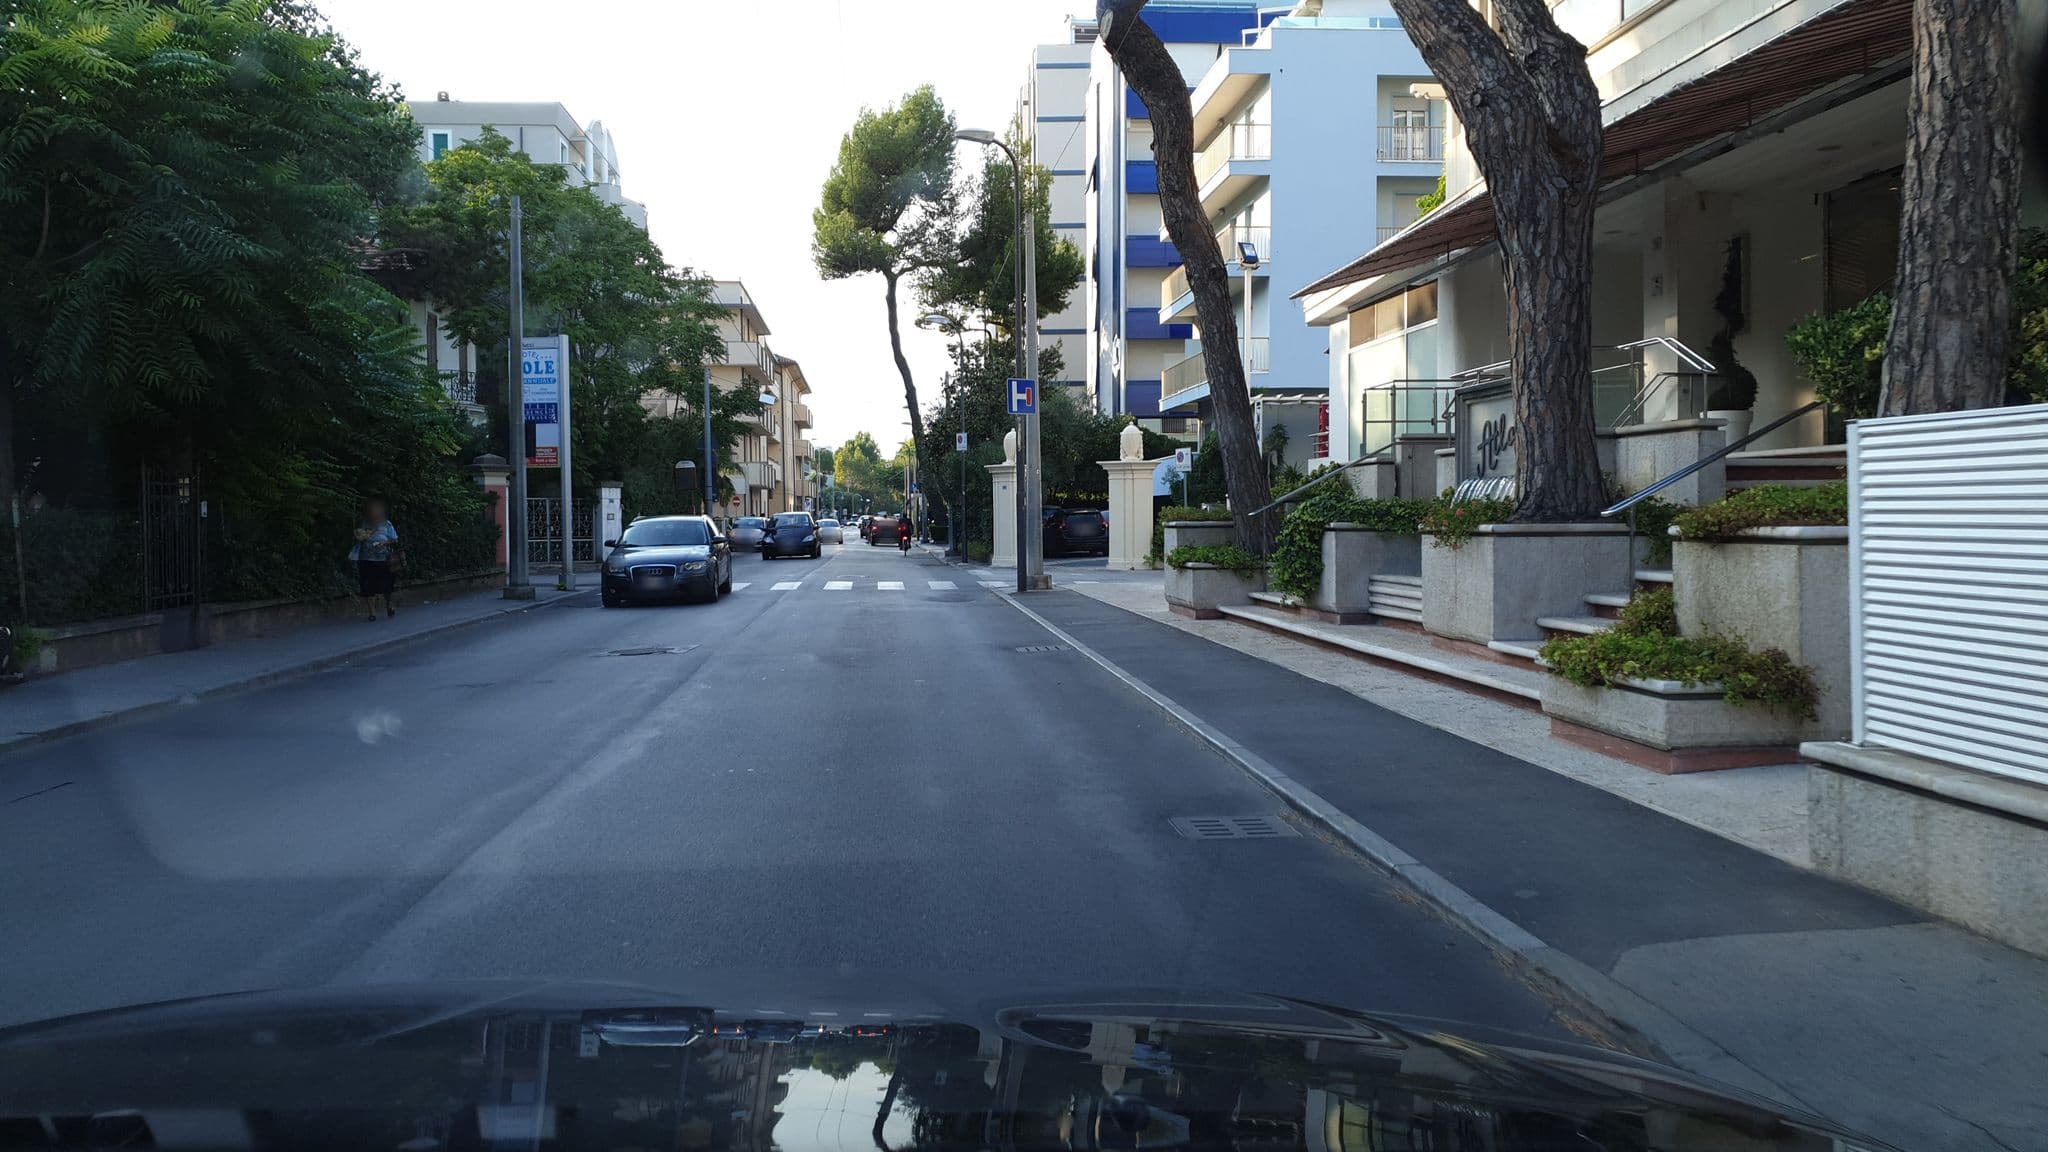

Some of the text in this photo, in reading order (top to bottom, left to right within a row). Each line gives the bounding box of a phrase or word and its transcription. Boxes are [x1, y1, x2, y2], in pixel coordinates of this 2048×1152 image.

[522, 351, 540, 360] OTEL
[523, 360, 555, 375] OLE
[1476, 412, 1517, 479] Atla
